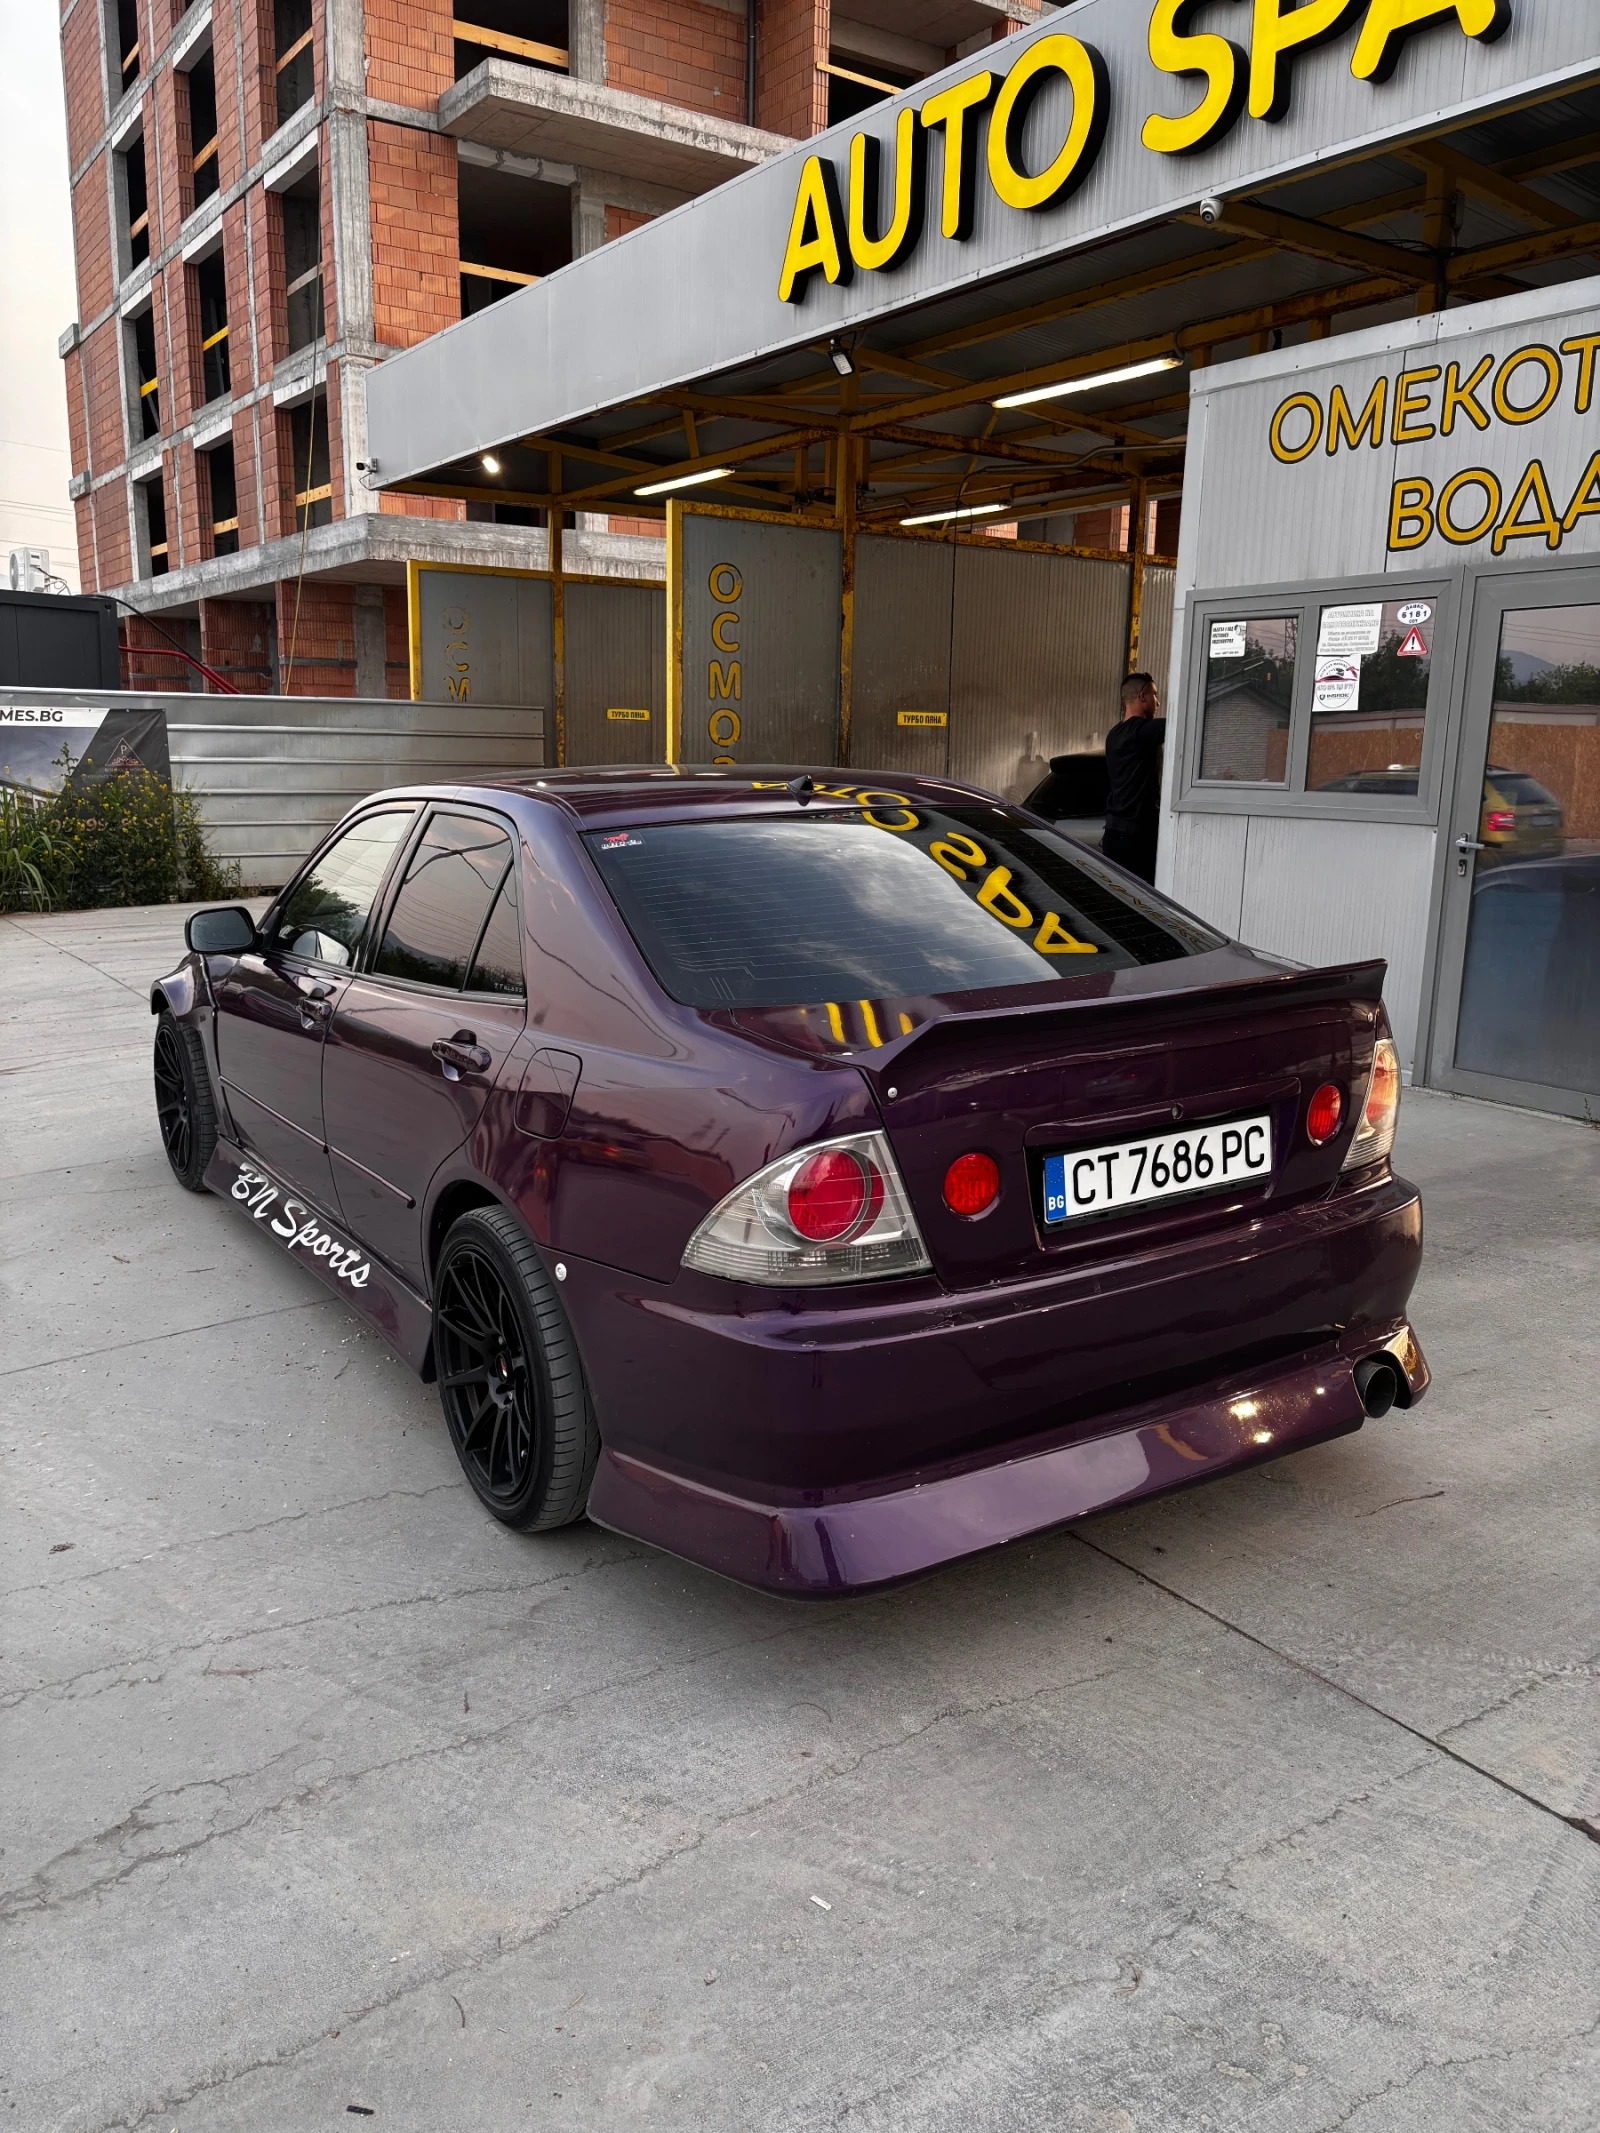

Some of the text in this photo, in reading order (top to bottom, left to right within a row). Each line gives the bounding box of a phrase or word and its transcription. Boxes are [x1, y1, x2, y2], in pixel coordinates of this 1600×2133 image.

[778, 33, 1110, 304] AUTO
[708, 562, 743, 765] ОСМО
[0, 710, 63, 722] MES.BG
[903, 715, 924, 723] ТУРБО
[1048, 1195, 1065, 1211] BG
[270, 1199, 371, 1288] Sports
